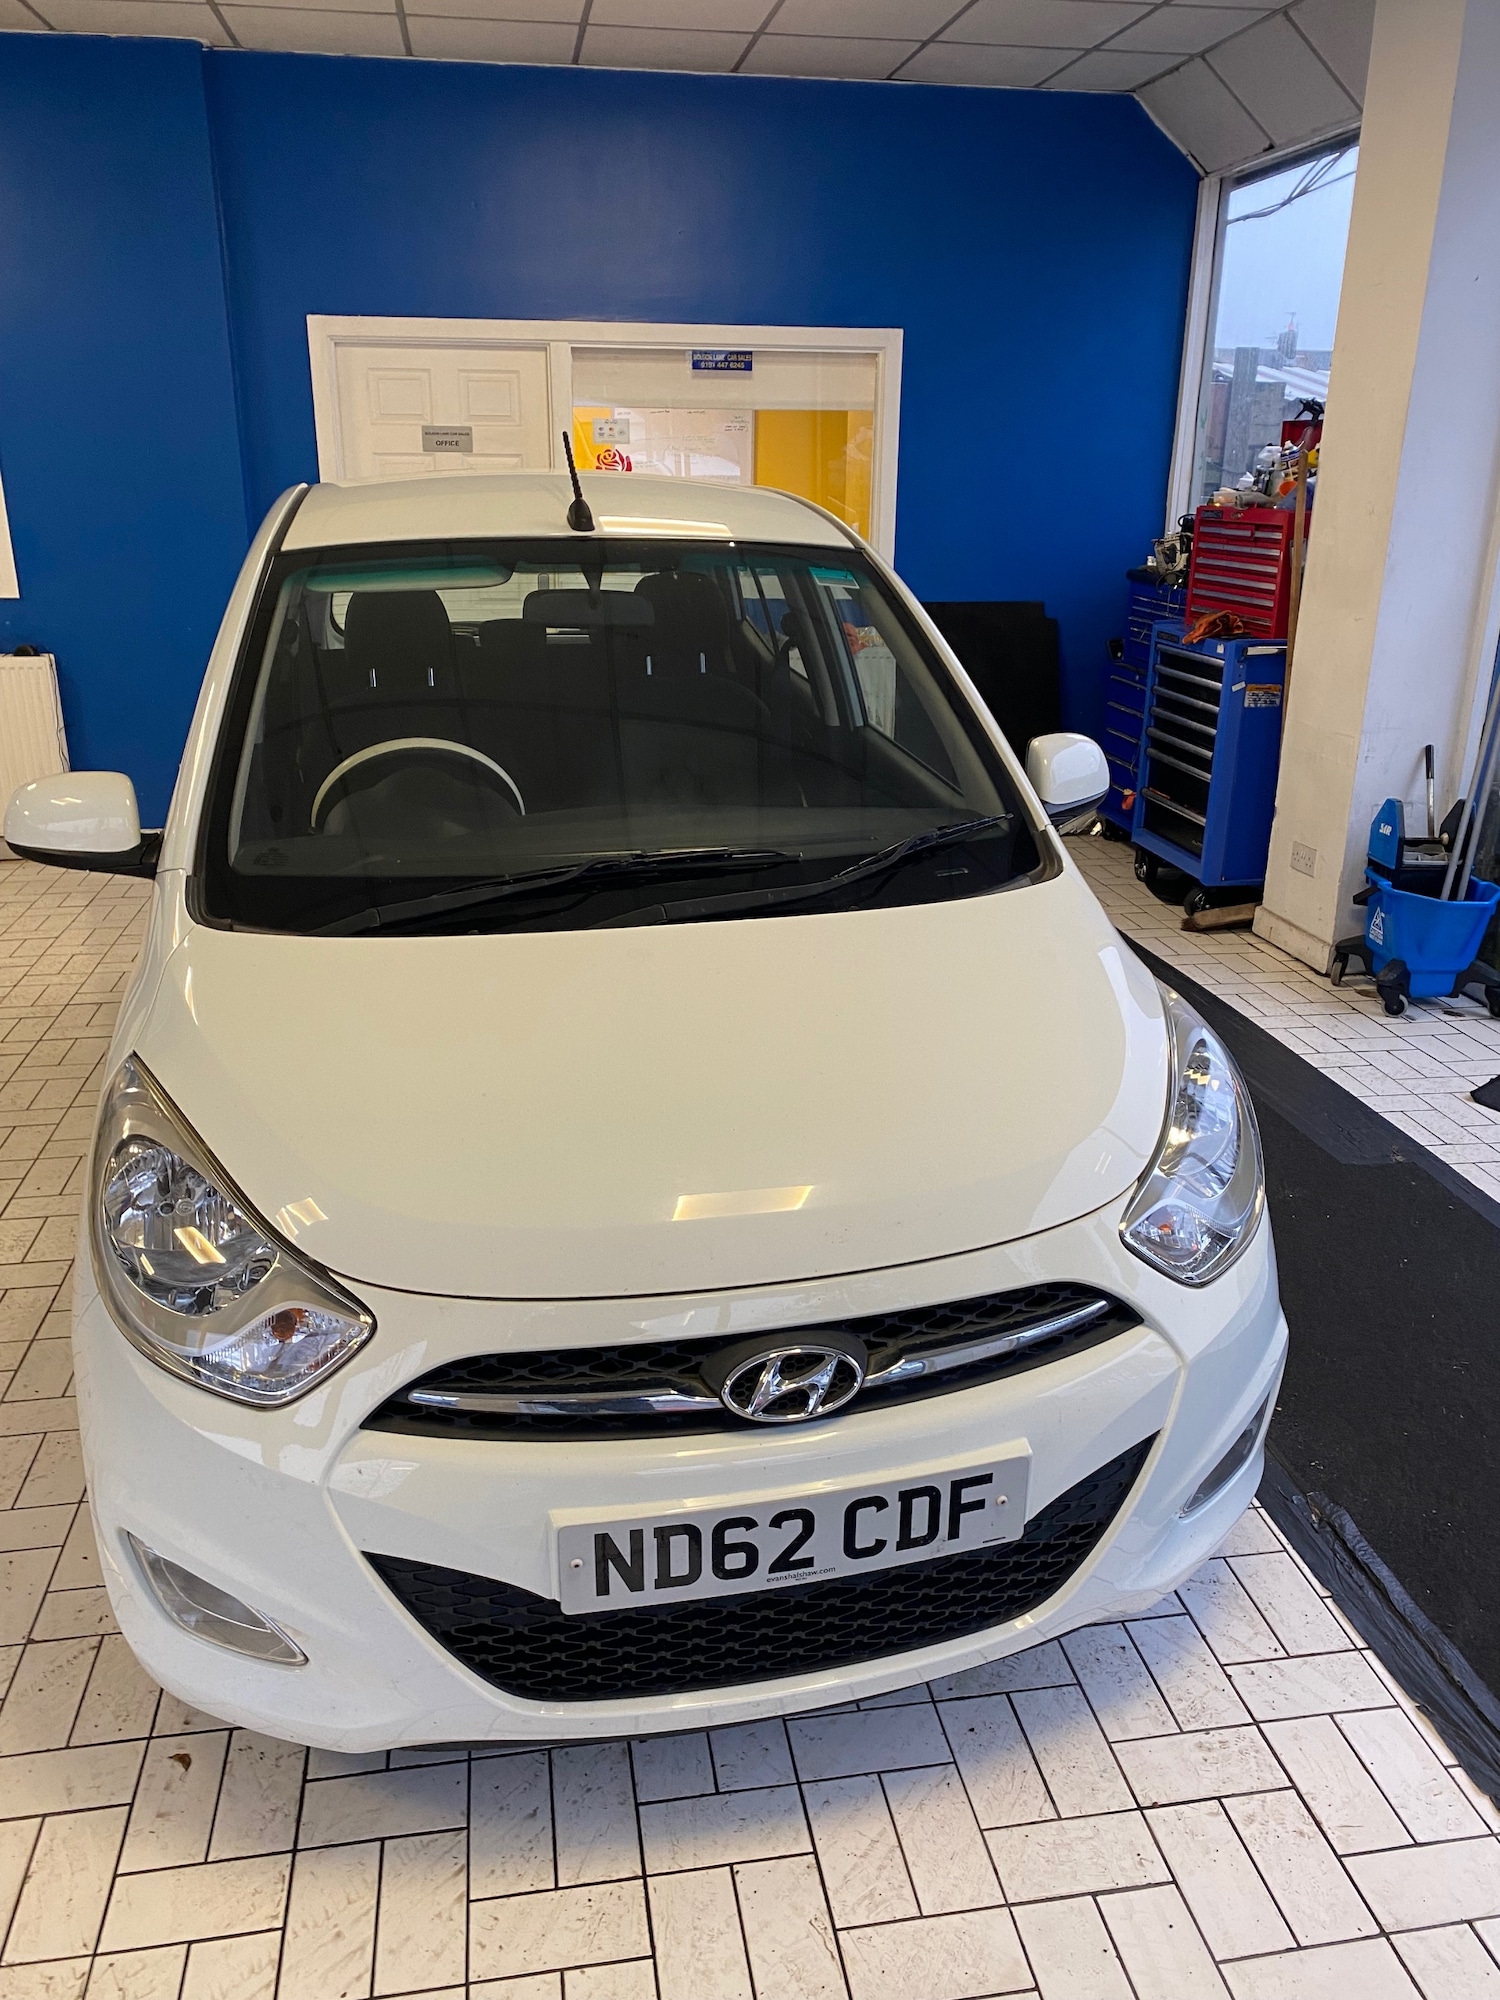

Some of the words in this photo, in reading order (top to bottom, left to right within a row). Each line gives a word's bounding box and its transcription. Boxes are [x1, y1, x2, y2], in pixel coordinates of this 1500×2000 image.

[594, 1508, 815, 1597] ND62
[843, 1472, 994, 1560] CDF
[766, 1566, 836, 1583] evanshalshaw.com
